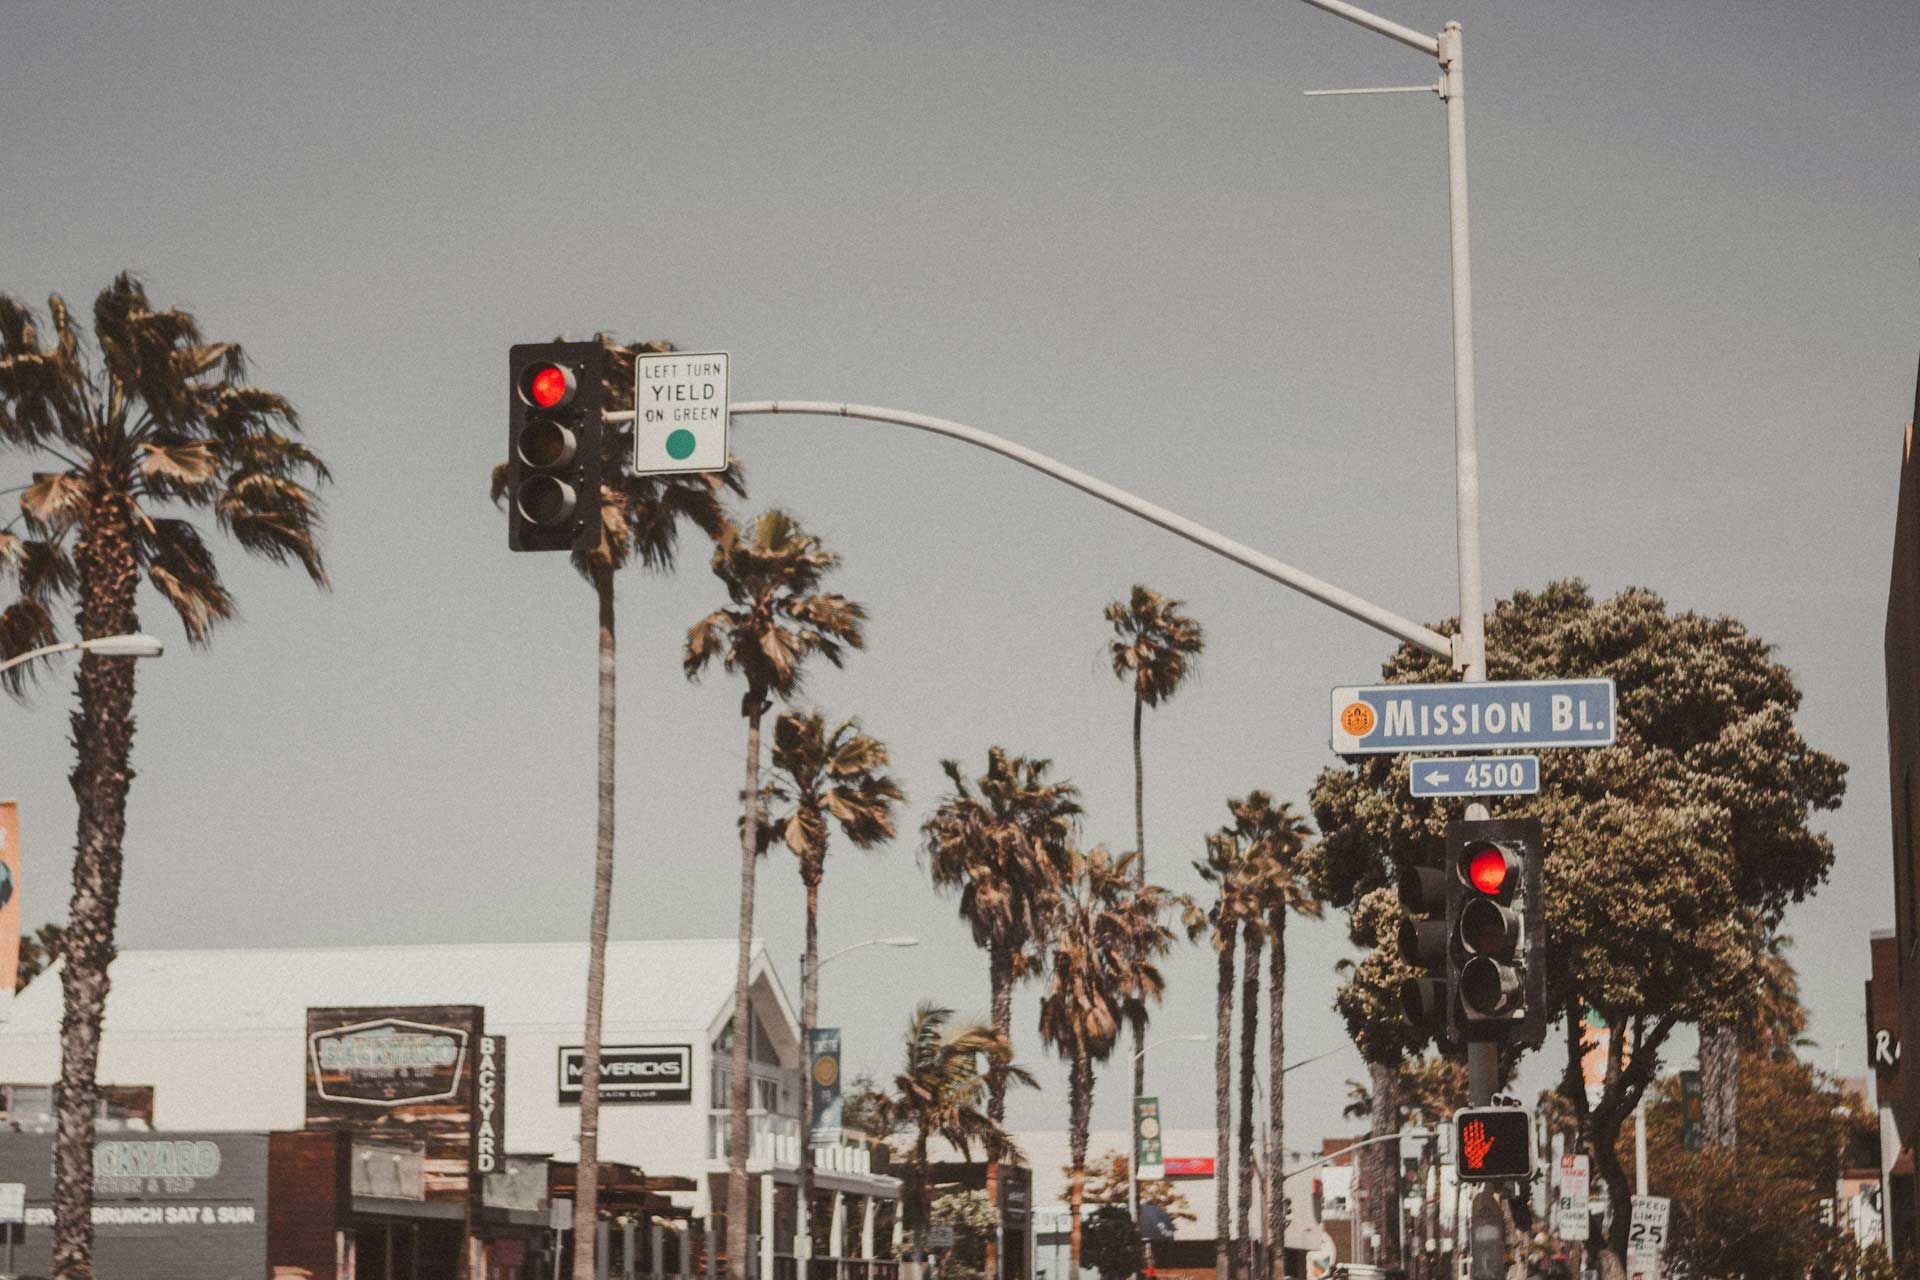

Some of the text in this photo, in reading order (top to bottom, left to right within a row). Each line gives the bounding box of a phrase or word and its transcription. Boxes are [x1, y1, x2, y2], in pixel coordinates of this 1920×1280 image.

[645, 363, 721, 379] LEFT TURN
[651, 383, 715, 401] YIELD
[645, 407, 719, 422] ON GREEN
[1464, 763, 1524, 789] 4500
[568, 1061, 680, 1075] MVERICKS
[478, 1037, 496, 1173] BACKYARD
[1632, 1199, 1667, 1212] SPEED
[164, 1207, 200, 1224] SAT
[200, 1207, 216, 1224] &
[217, 1207, 255, 1223] SUN
[1633, 1212, 1663, 1223] LIMIT
[1630, 1223, 1663, 1244] 25
